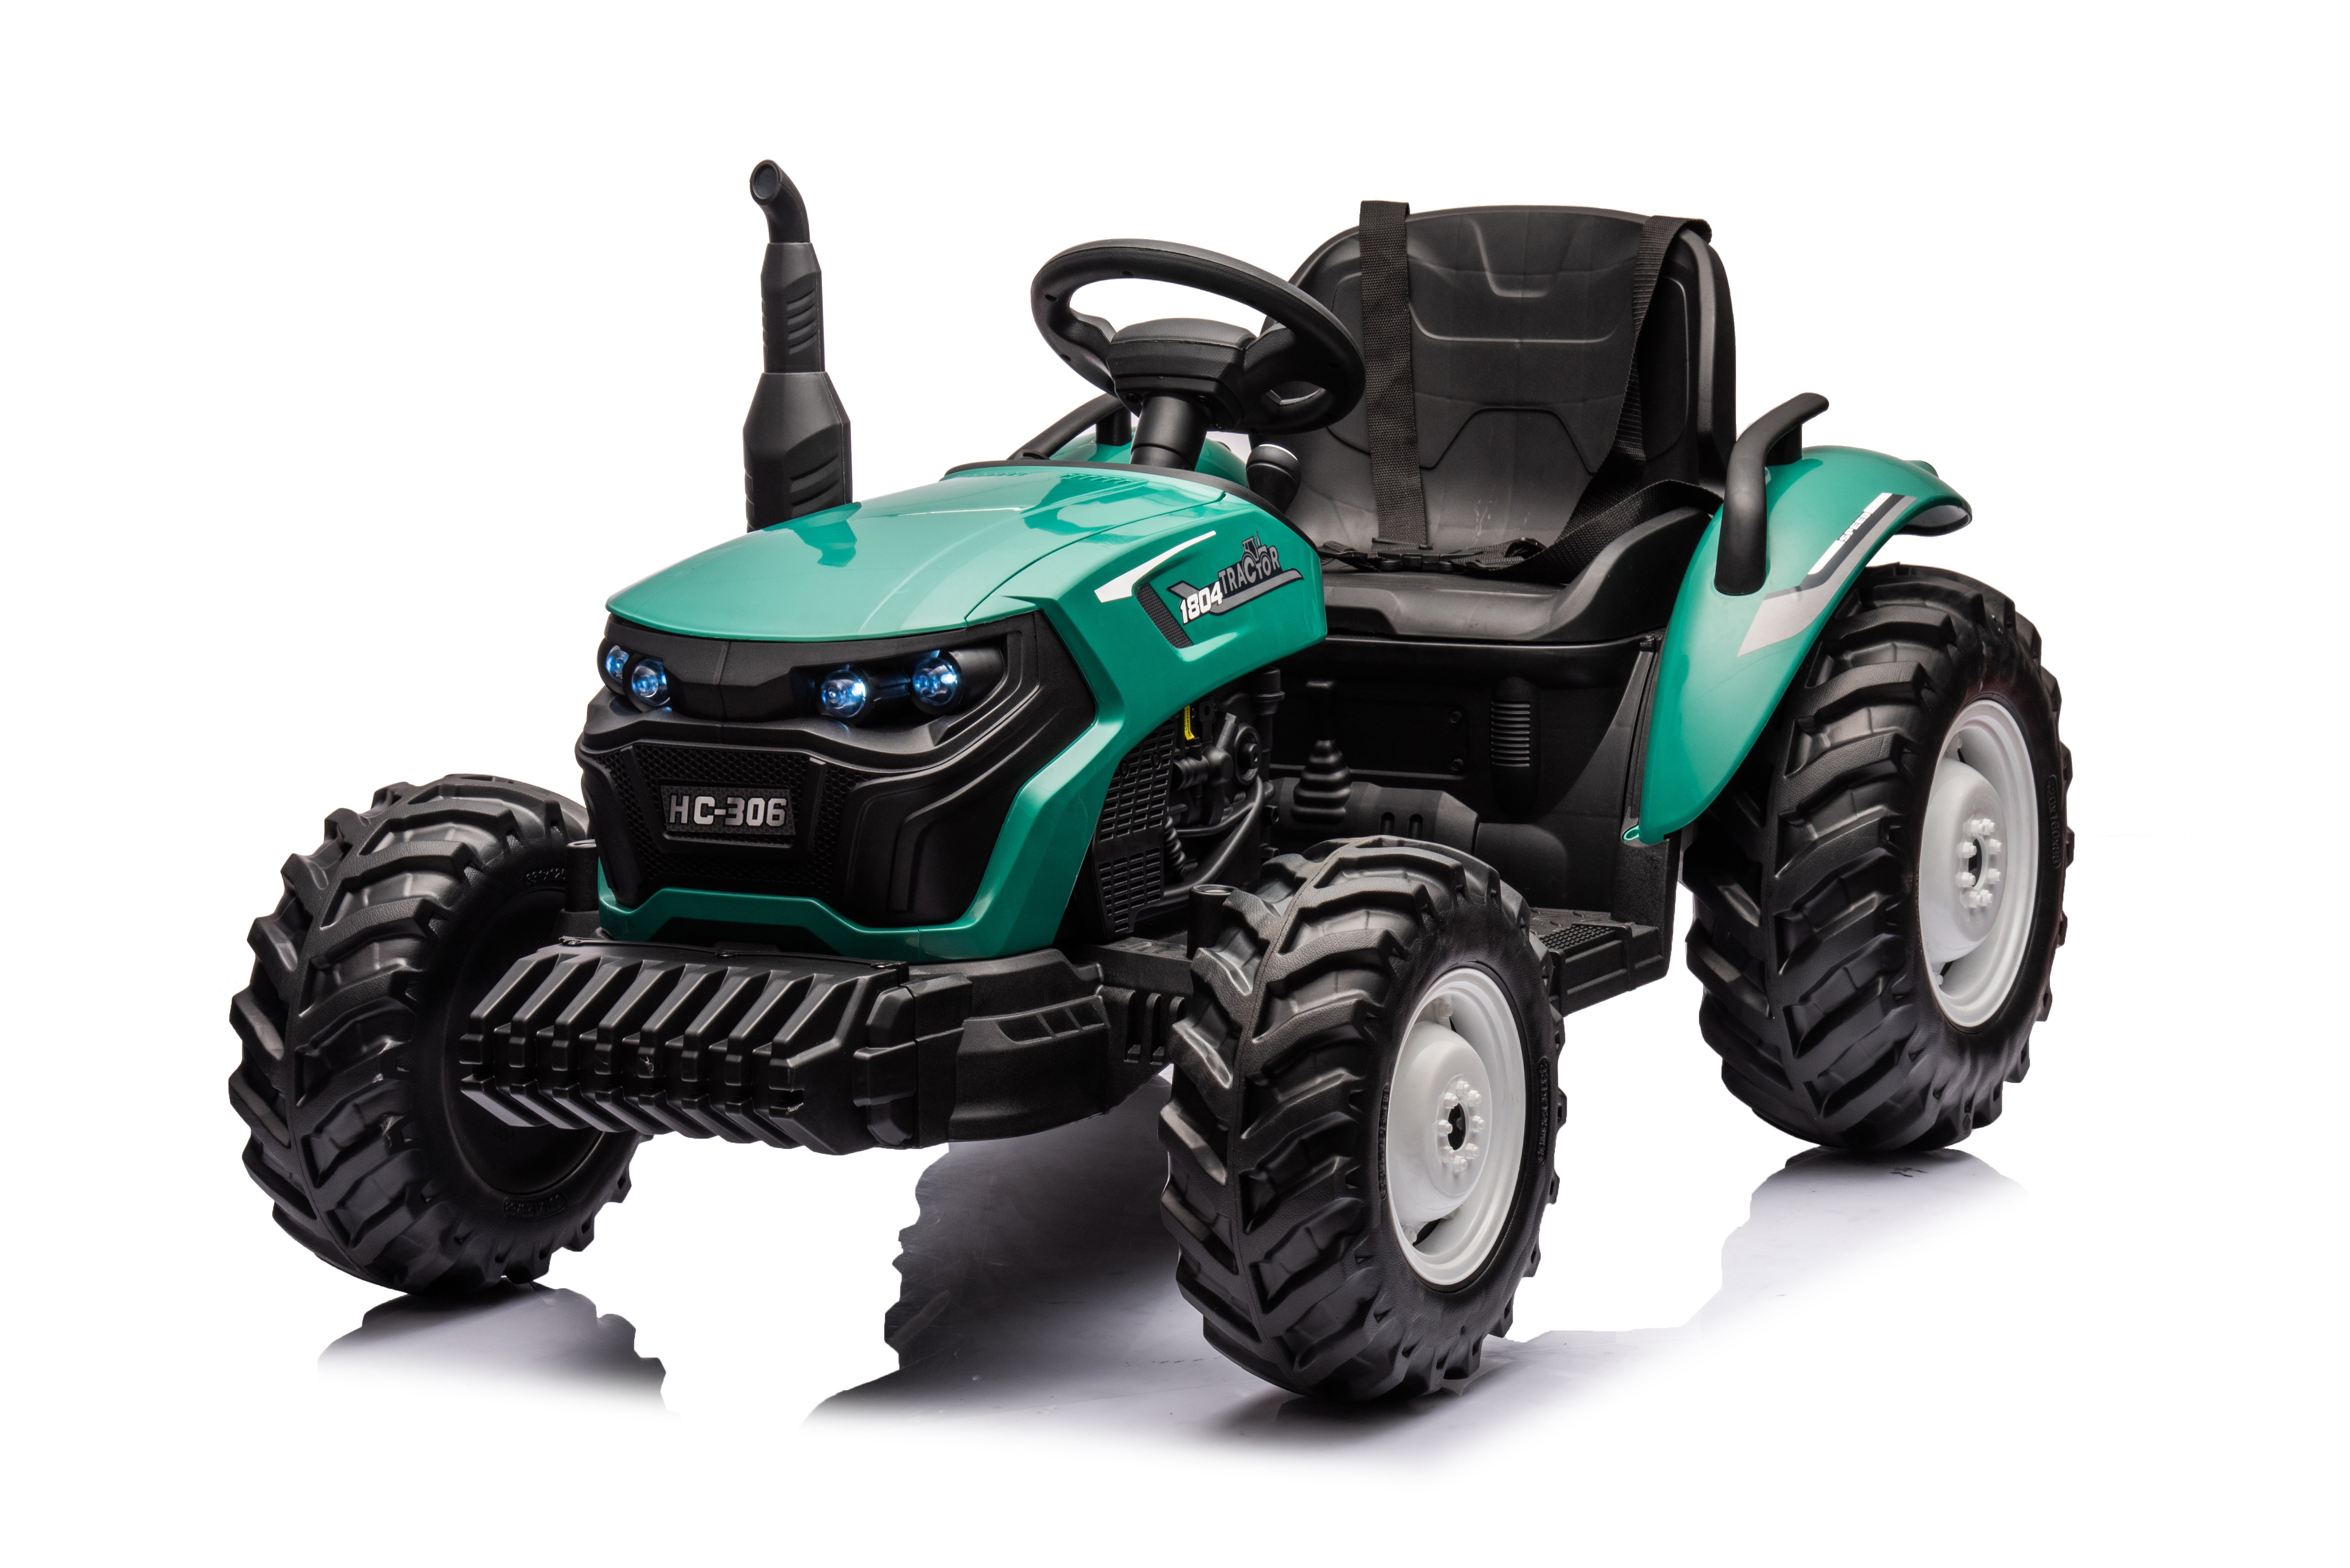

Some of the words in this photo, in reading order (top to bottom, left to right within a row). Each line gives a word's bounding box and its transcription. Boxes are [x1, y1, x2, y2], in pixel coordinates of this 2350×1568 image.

[1839, 512, 1871, 542] SPEED
[1180, 581, 1223, 623] 1804
[1218, 546, 1280, 594] TRACTOR
[670, 795, 787, 826] HC-306
